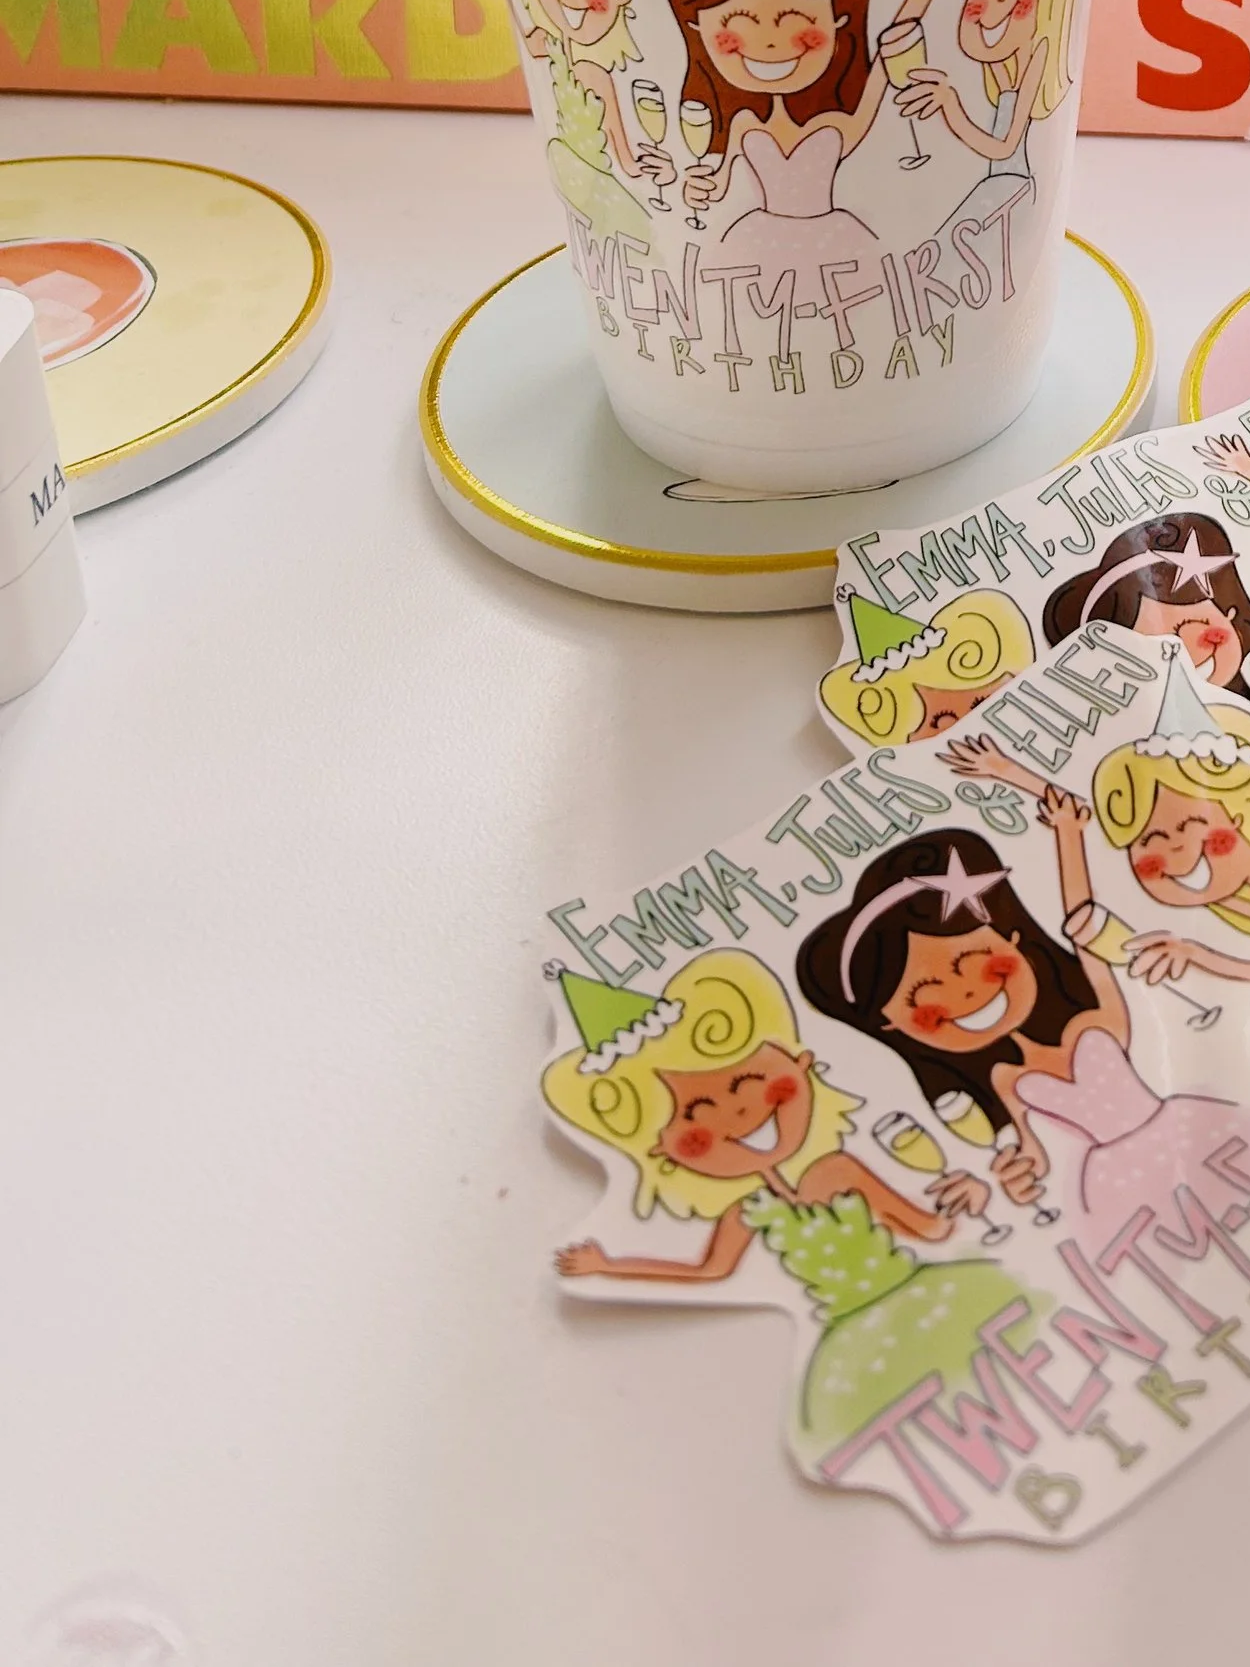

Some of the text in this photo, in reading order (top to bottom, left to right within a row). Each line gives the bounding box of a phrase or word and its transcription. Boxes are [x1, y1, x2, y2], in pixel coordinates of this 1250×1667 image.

[552, 179, 1031, 363] TWENTY-FIRST
[596, 296, 954, 394] BIRTHDAY
[848, 502, 1057, 613] EMMA,
[982, 620, 1159, 774] ELLIE'S
[954, 780, 1029, 836] &
[547, 847, 799, 990] EMMA,
